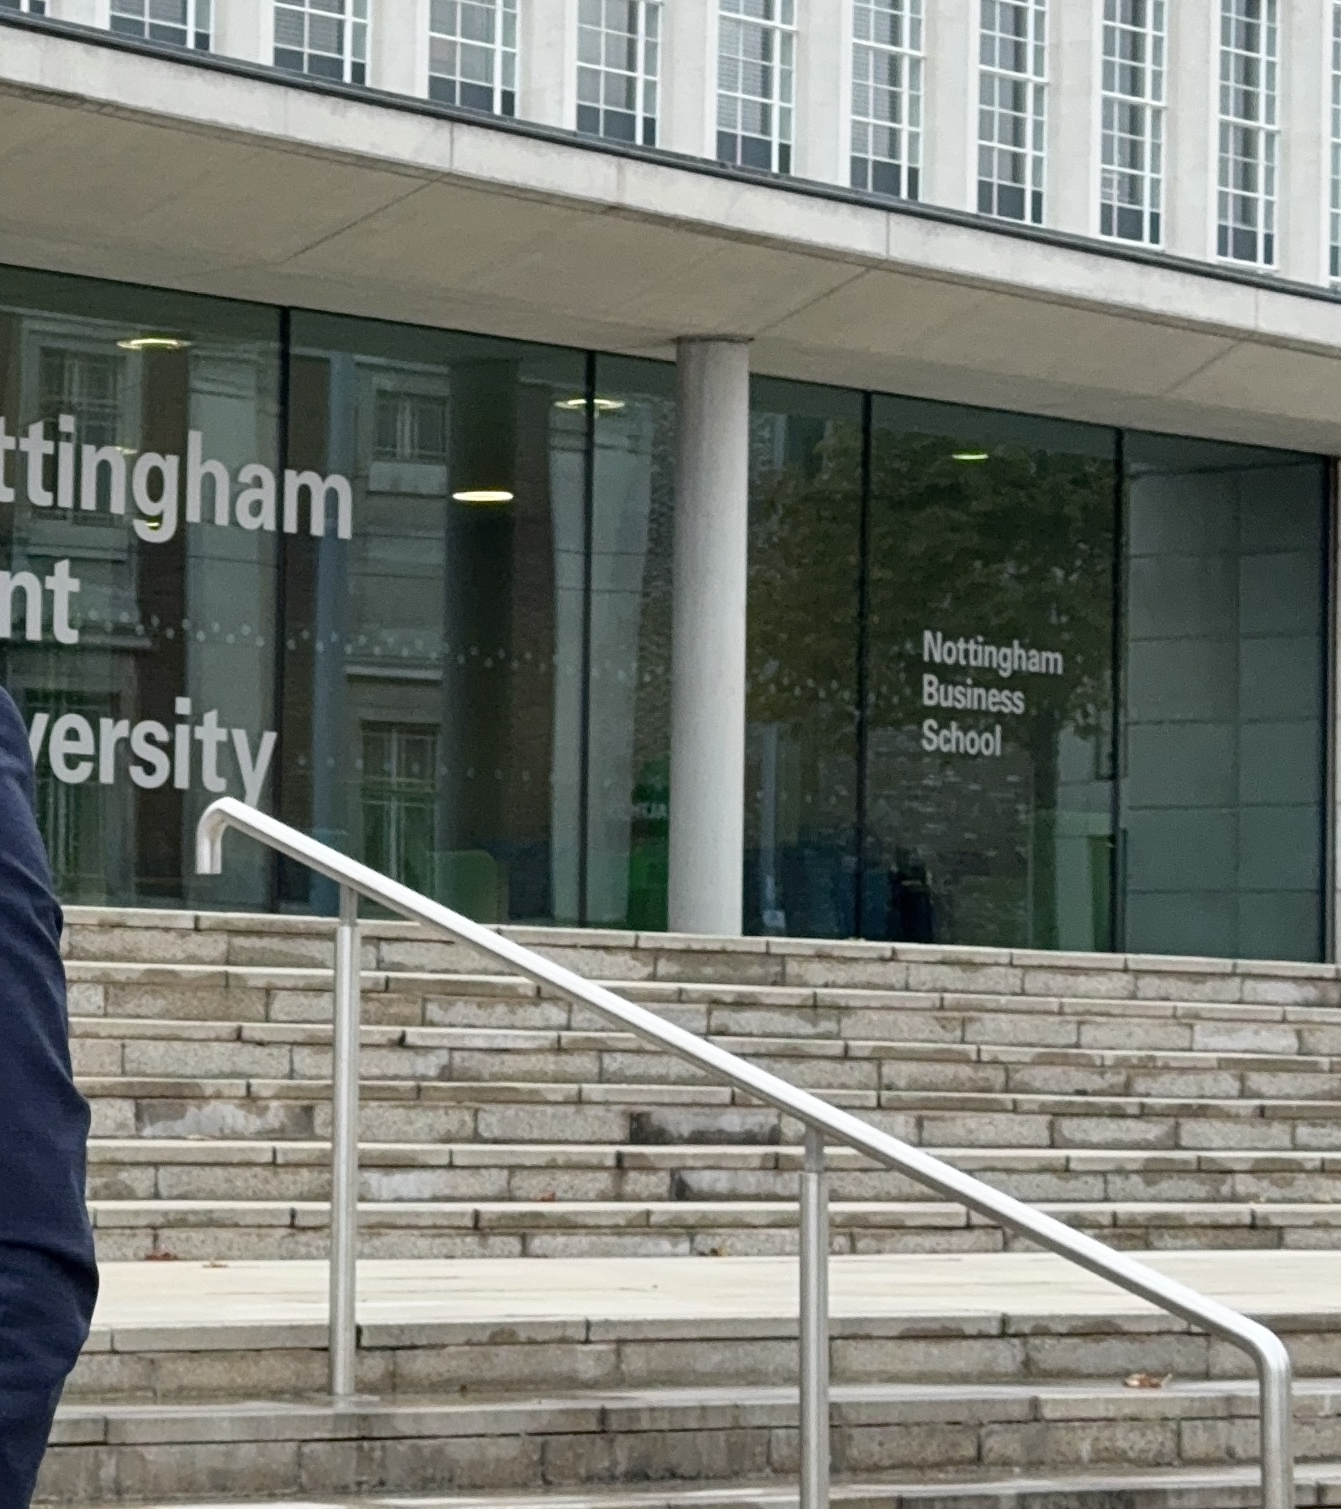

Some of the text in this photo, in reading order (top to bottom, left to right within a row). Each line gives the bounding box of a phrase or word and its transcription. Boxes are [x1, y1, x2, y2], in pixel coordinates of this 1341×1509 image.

[922, 629, 1064, 679] Nottingham
[922, 673, 1026, 715] Business
[921, 718, 1002, 757] School
